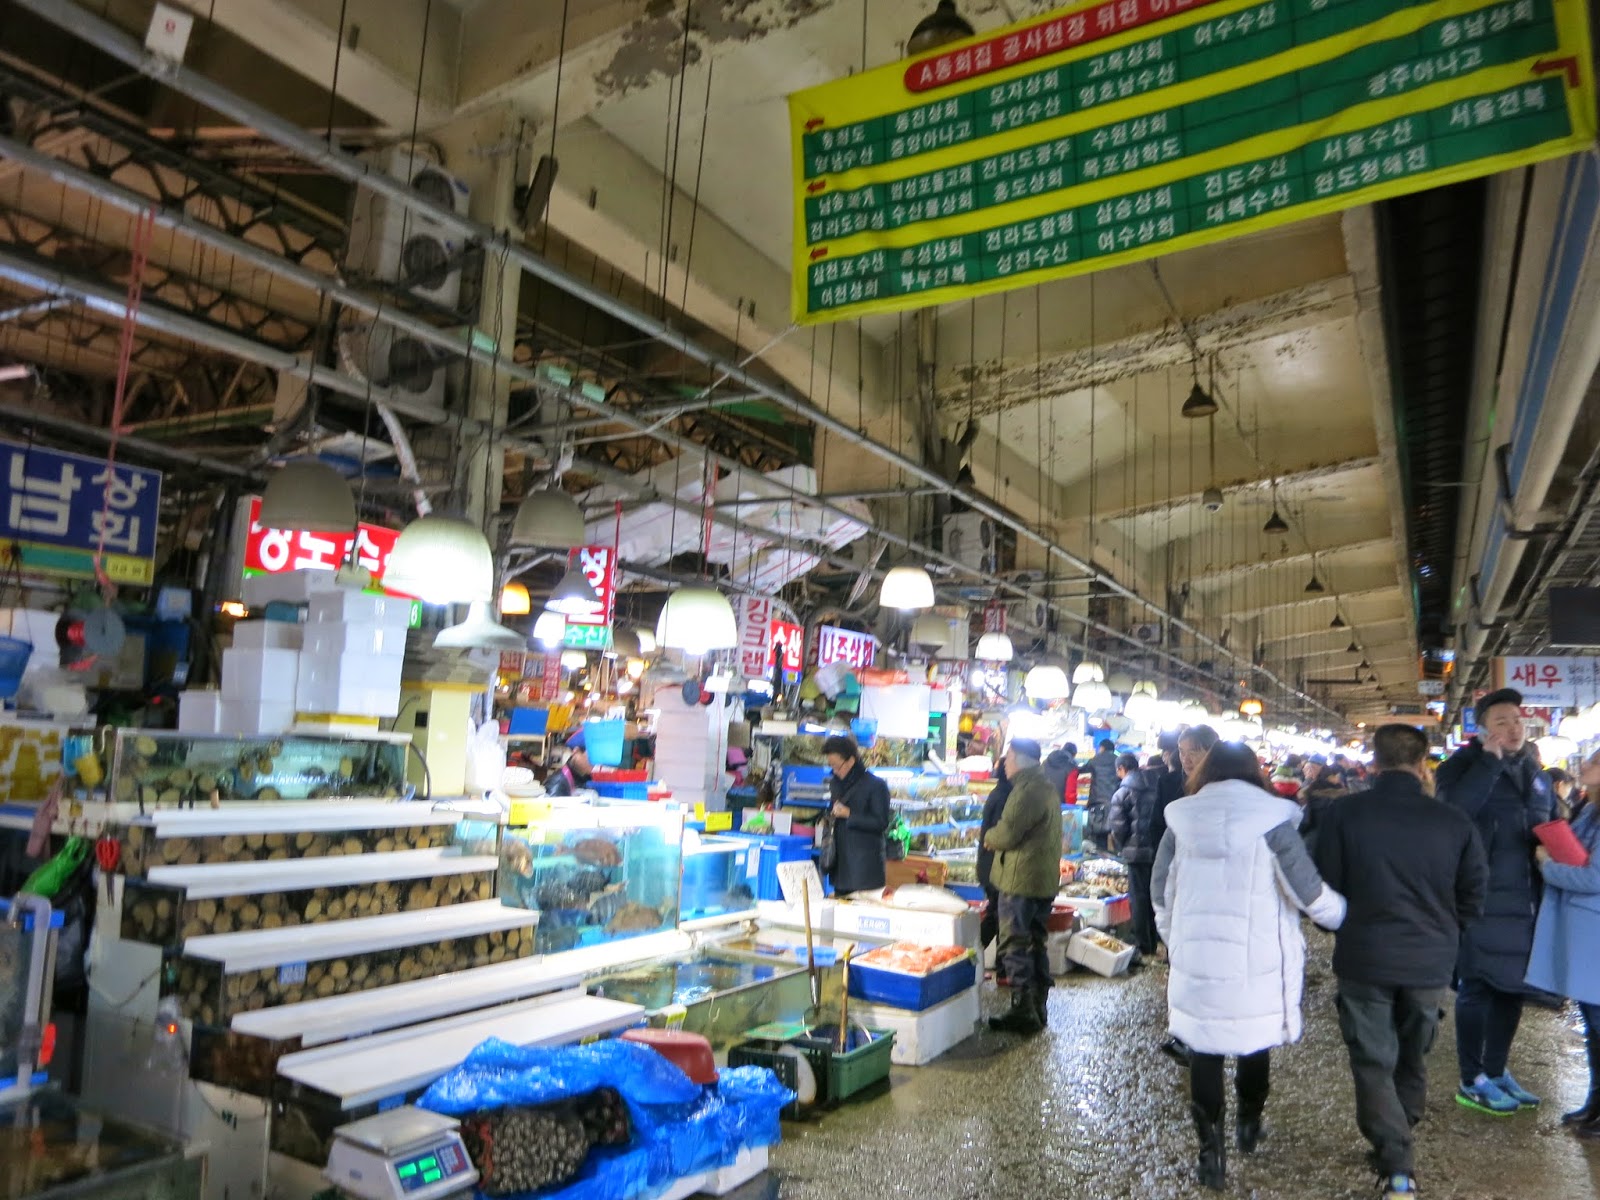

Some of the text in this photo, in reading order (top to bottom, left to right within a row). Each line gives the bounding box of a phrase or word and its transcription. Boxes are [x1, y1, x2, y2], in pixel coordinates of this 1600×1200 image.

[1003, 16, 1086, 61] 공사현장
[1204, 156, 1287, 198] 진도수산
[1323, 119, 1412, 162] 서울수산
[1097, 215, 1175, 251] 여수상회
[9, 453, 148, 554] 남 상회
[564, 626, 607, 646] 수산
[741, 597, 770, 677] 킹크랩
[767, 625, 802, 668] 수산
[1510, 662, 1563, 689] 새우
